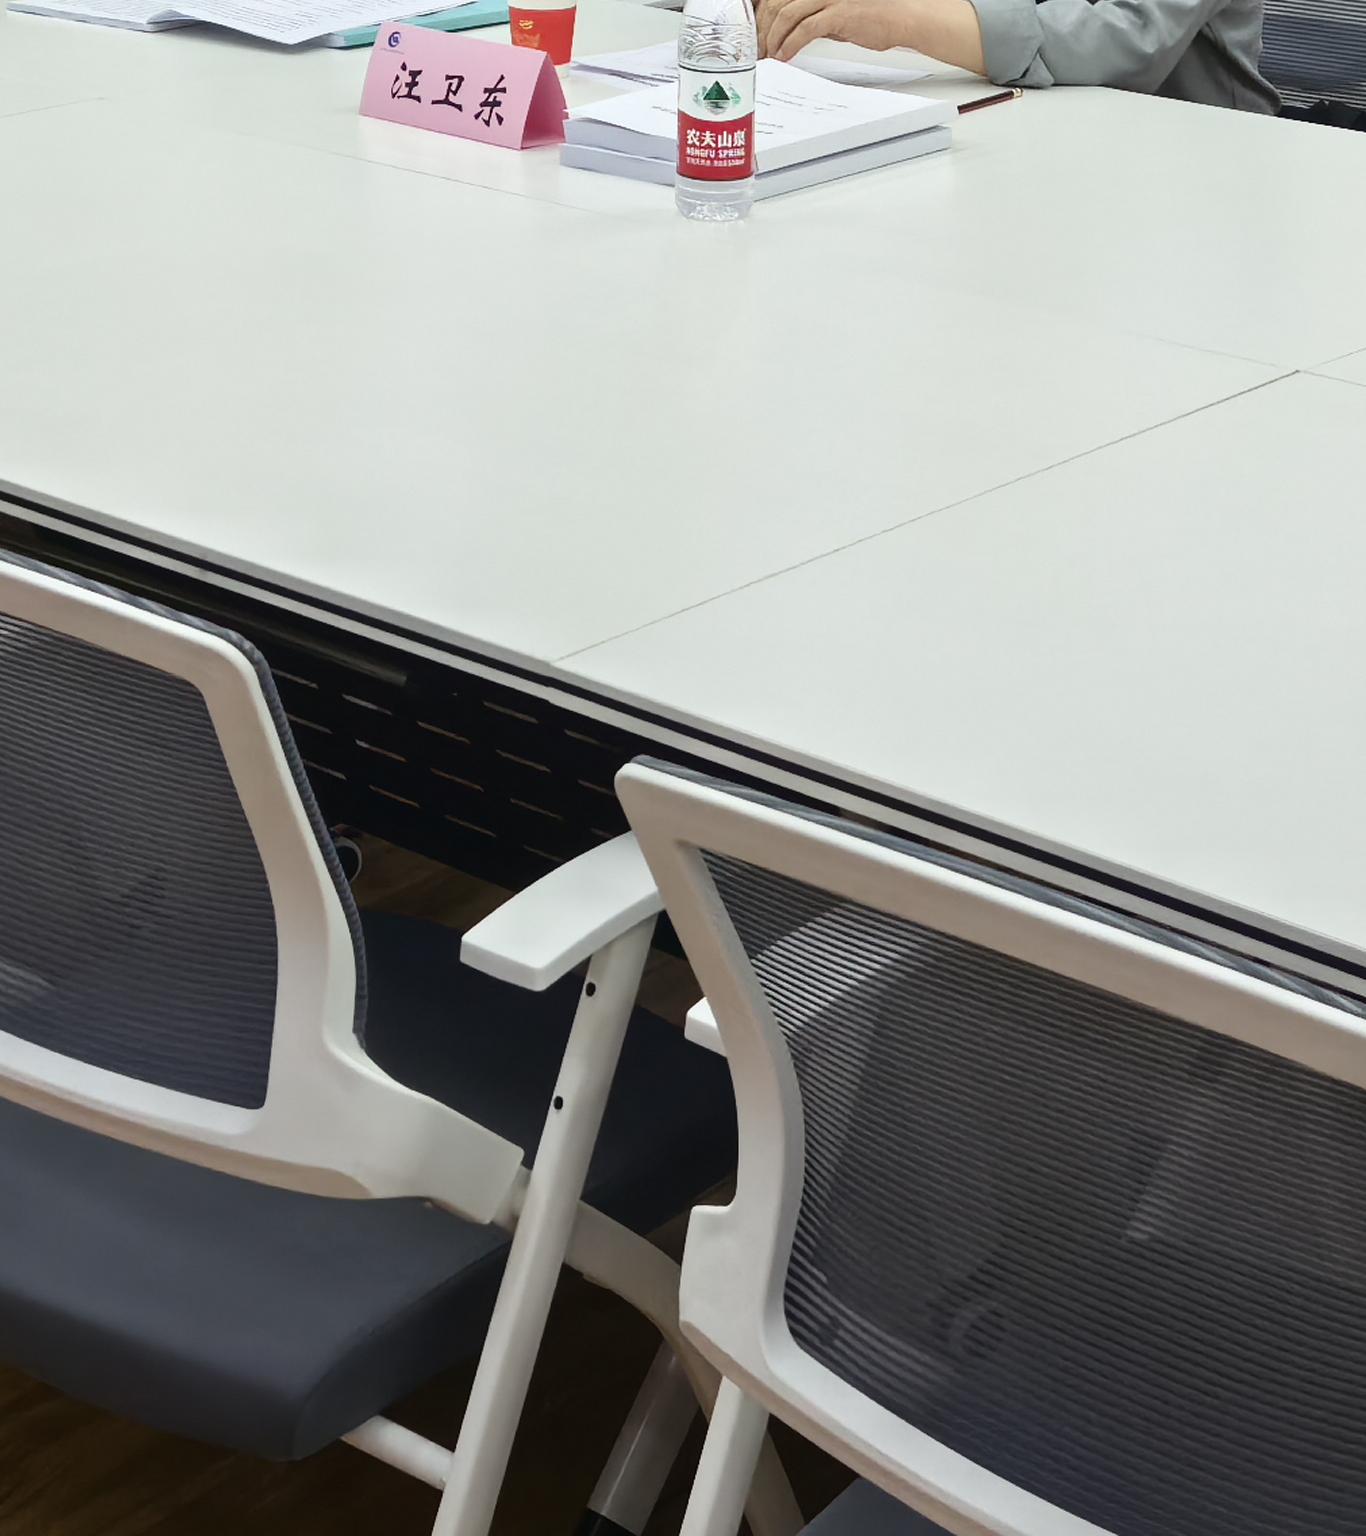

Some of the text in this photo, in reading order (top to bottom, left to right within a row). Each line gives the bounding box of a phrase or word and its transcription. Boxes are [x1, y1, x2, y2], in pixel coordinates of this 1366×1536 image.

[391, 61, 507, 127] 汪卫东
[686, 128, 746, 148] 农夫山泉
